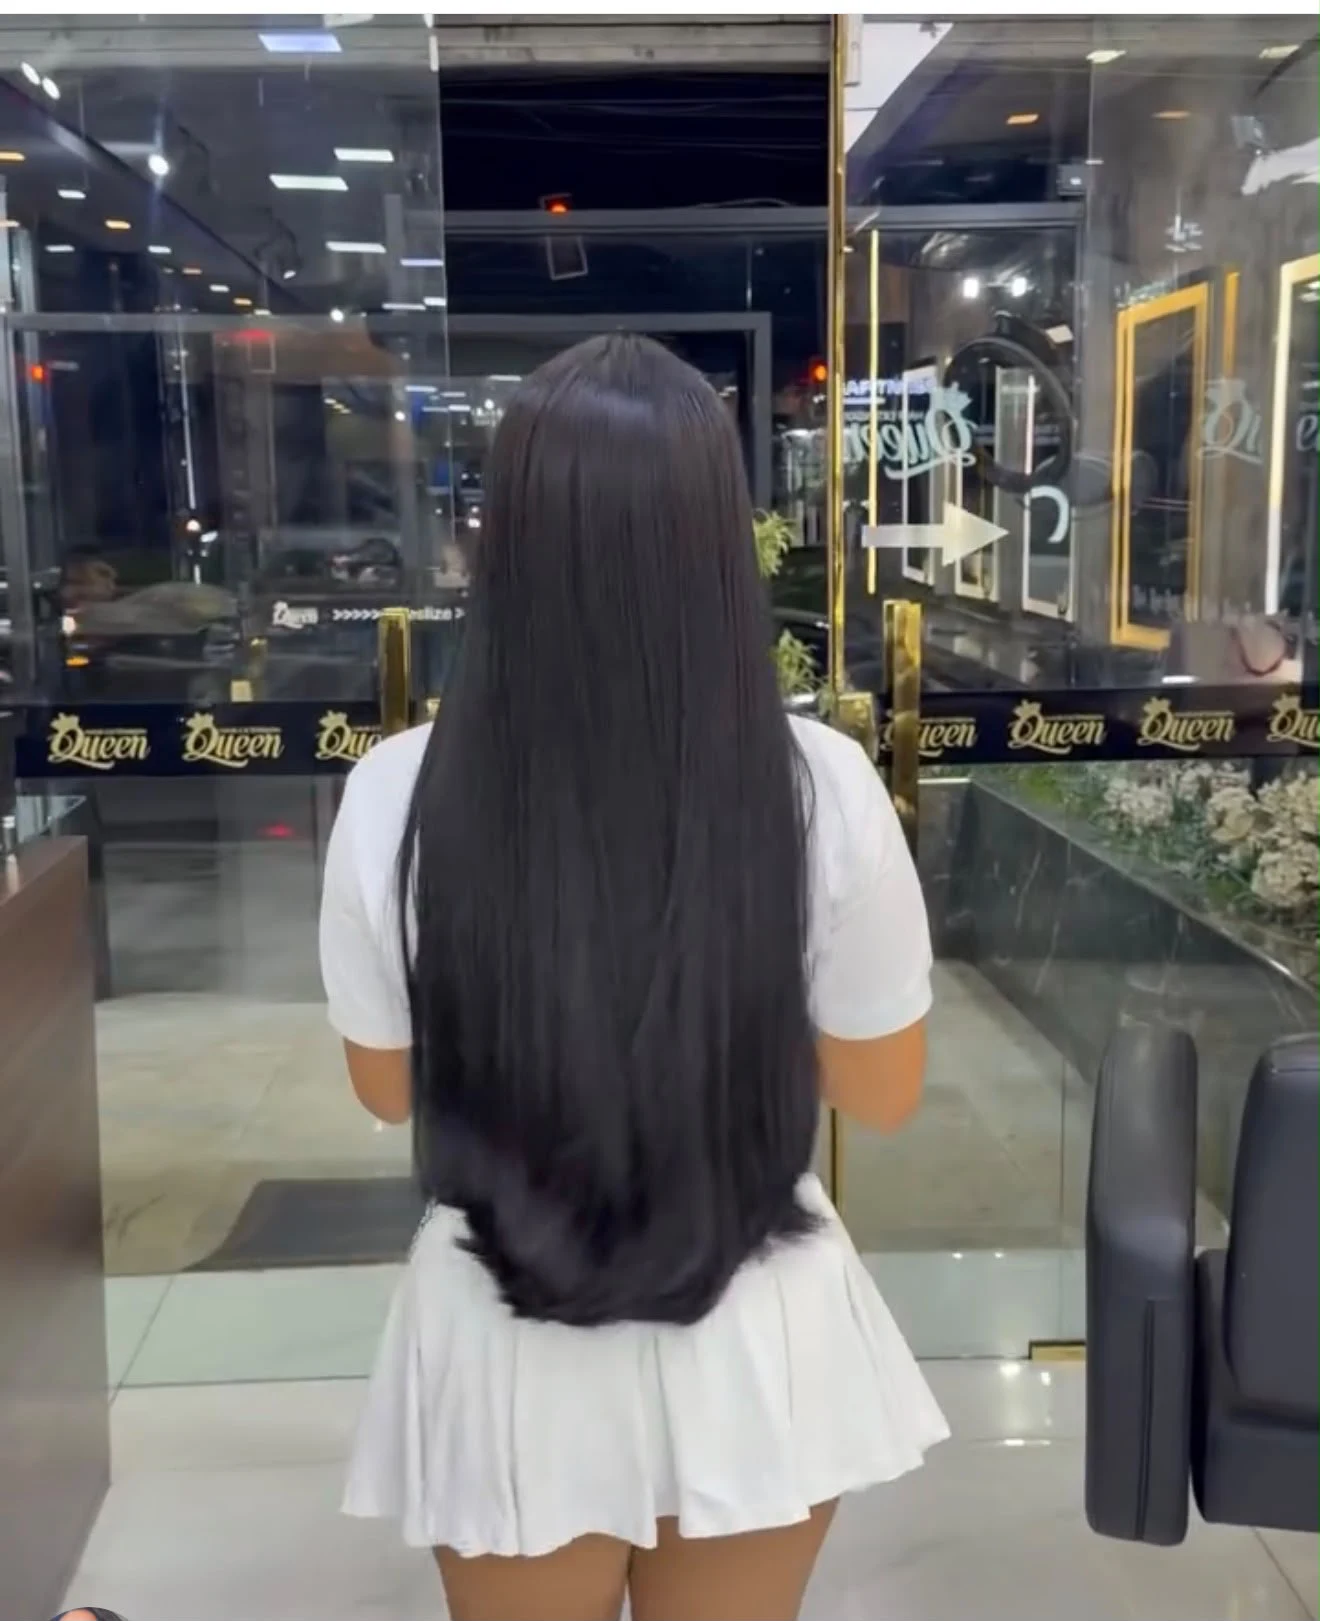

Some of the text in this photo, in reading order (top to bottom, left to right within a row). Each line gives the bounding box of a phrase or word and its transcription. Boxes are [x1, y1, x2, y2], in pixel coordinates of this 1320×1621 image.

[47, 722, 151, 770] Queen
[182, 721, 285, 769] Queen
[1008, 713, 1107, 756] Queen
[1137, 709, 1235, 752] Queen
